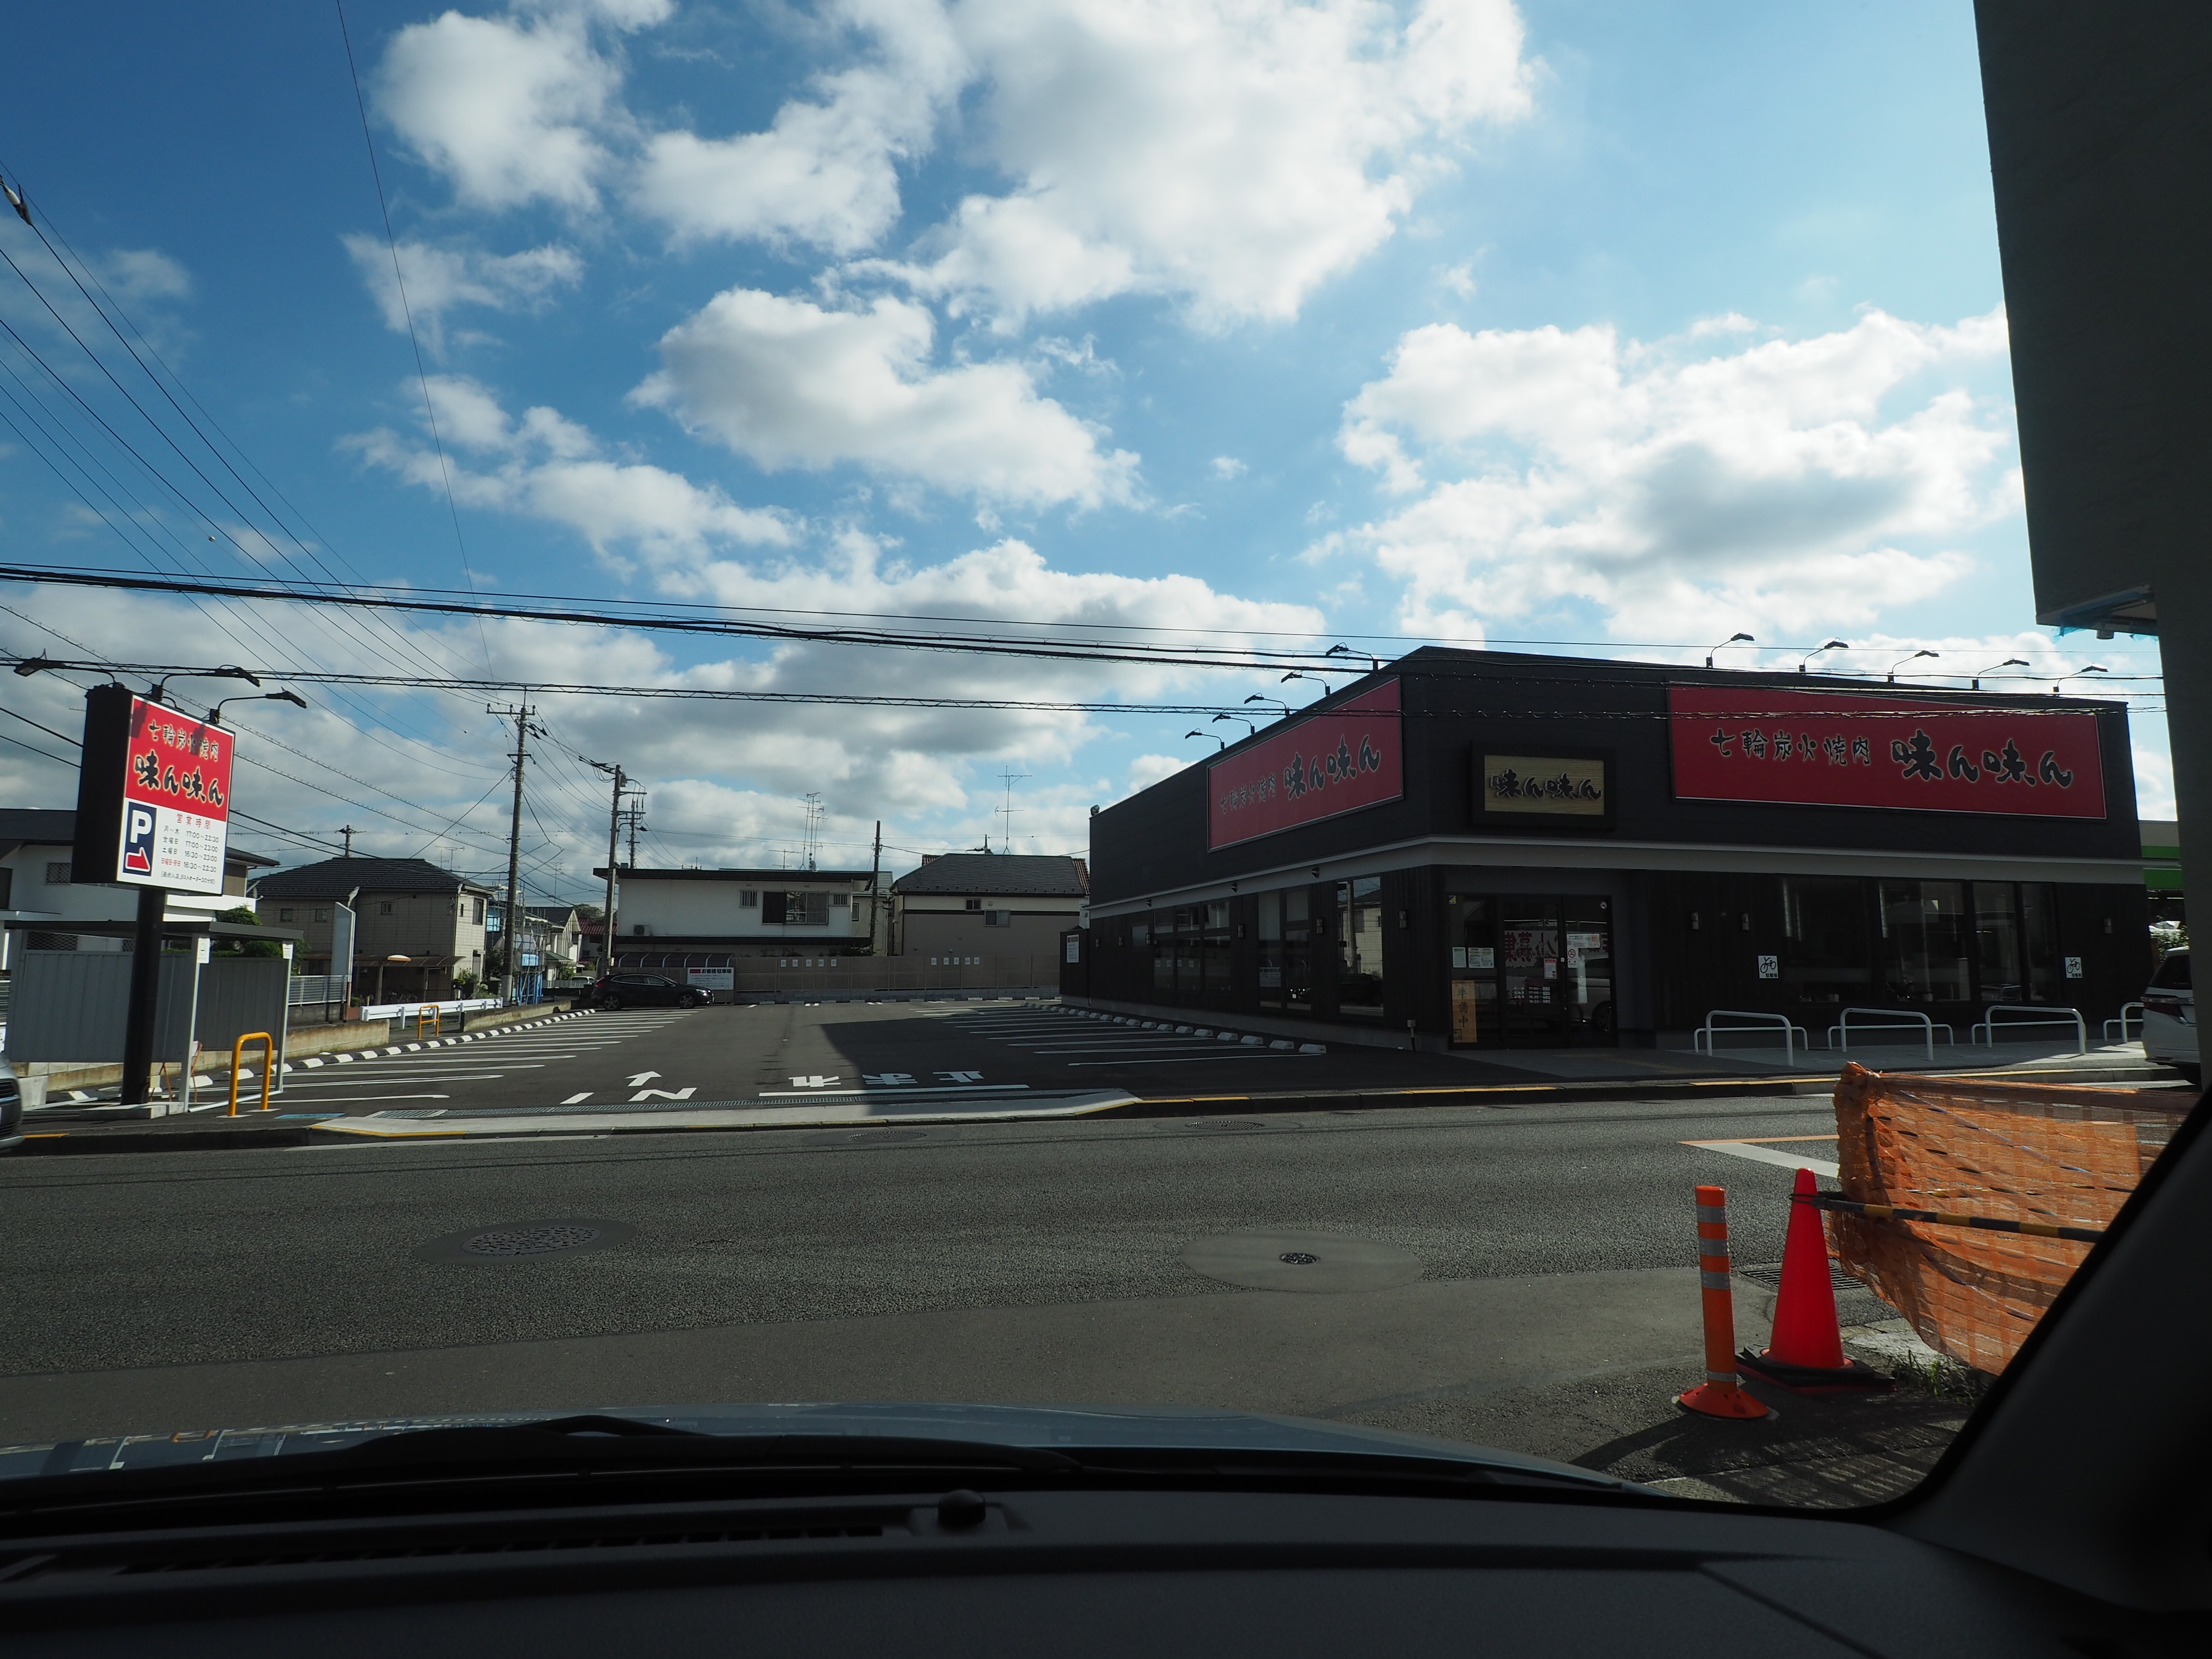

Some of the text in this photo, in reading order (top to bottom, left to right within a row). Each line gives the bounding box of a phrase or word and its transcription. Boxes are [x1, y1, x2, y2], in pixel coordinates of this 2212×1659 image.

[148, 720, 219, 761] 七輪炭火焼肉
[1710, 729, 2072, 788] 七輪炭火焼肉 味ん味ん
[134, 750, 224, 807] 味ん味ん
[1220, 734, 1381, 814] 七輪炭火焼肉 味ん味ん
[1491, 769, 1602, 800] 味ん味ん
[130, 809, 152, 843] P
[177, 813, 211, 829] 営業時間
[163, 836, 179, 844] 金曜日
